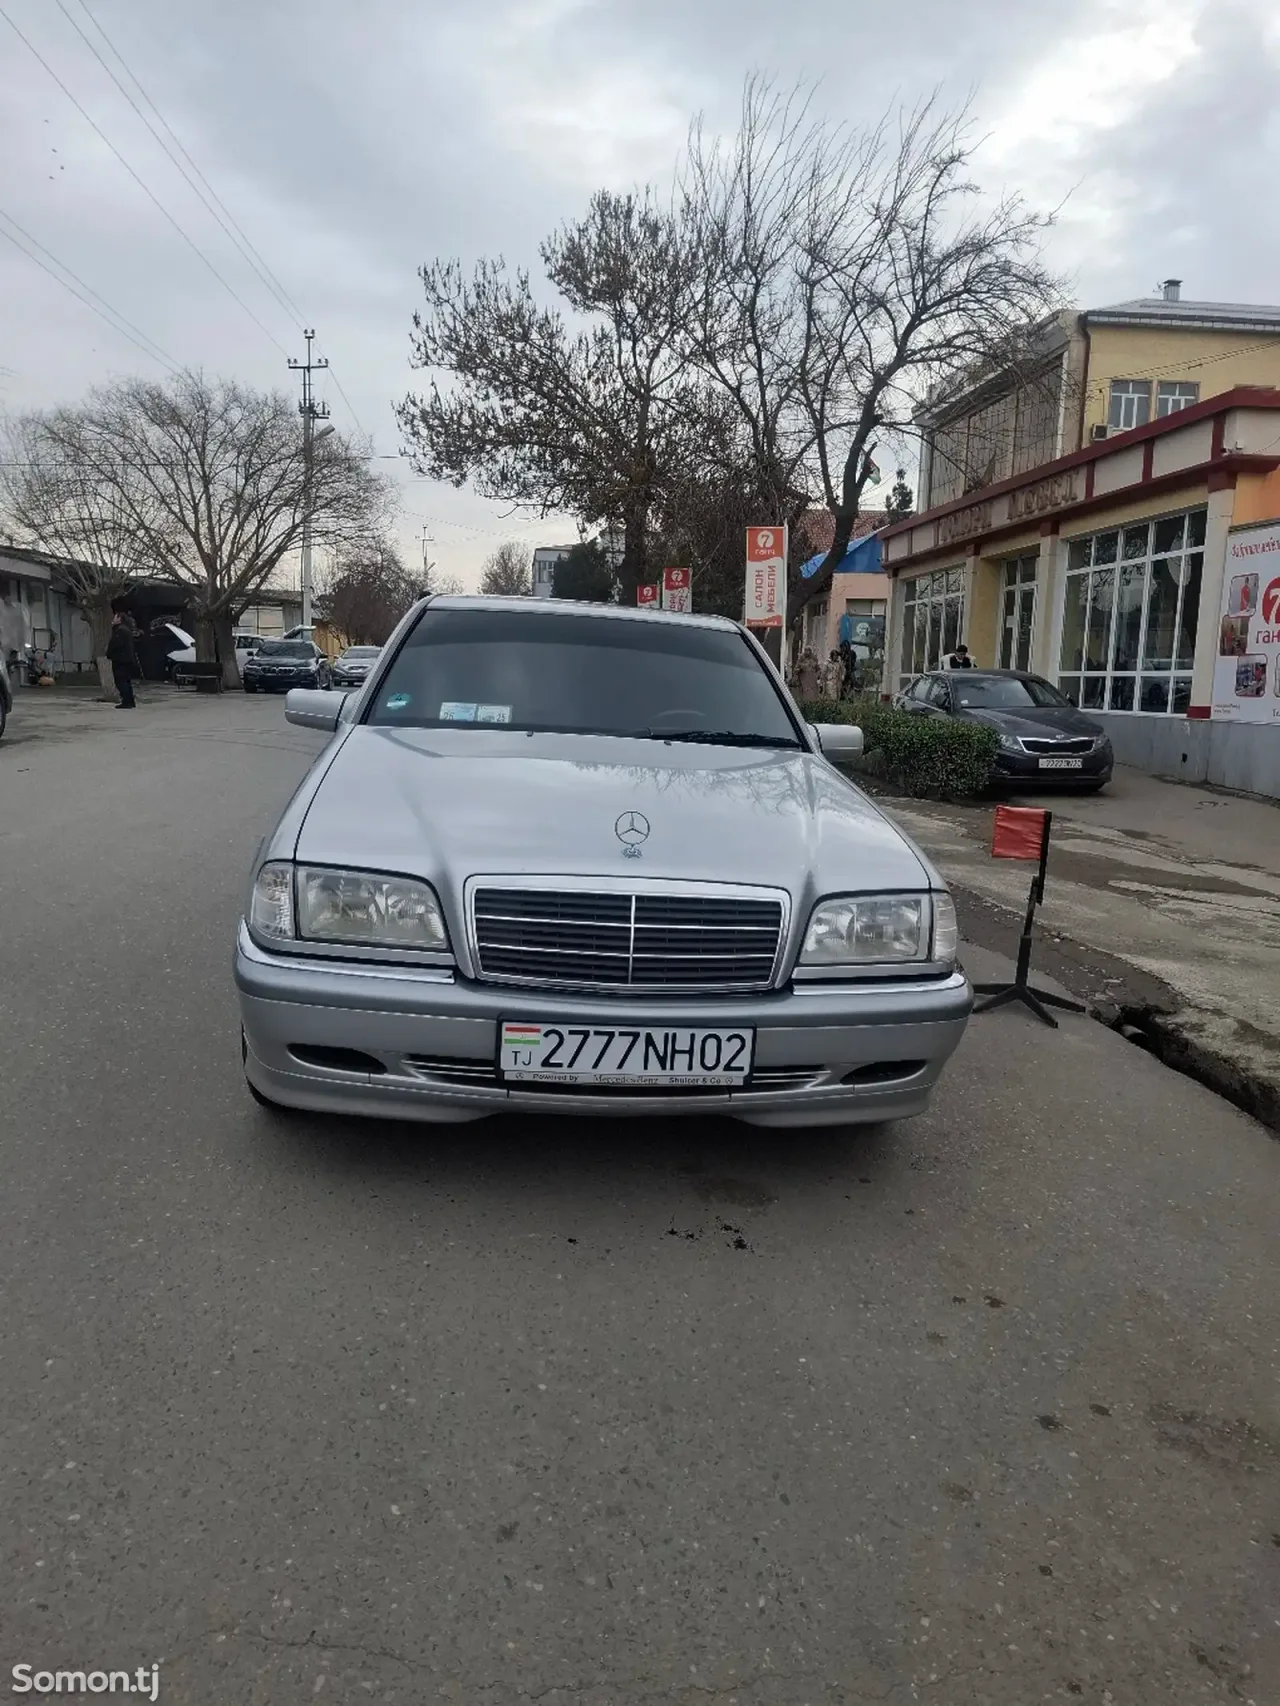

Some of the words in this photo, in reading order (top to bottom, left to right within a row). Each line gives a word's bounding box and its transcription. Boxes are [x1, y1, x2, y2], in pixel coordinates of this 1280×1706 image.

[761, 535, 770, 548] 7
[755, 570, 764, 608] САЛОН
[767, 565, 776, 613] МЕБЕЛИ
[511, 1050, 532, 1066] TJ
[541, 1028, 747, 1072] 2777NH02
[532, 1073, 567, 1081] Powered
[569, 1074, 579, 1082] by
[710, 1076, 721, 1084] Co
